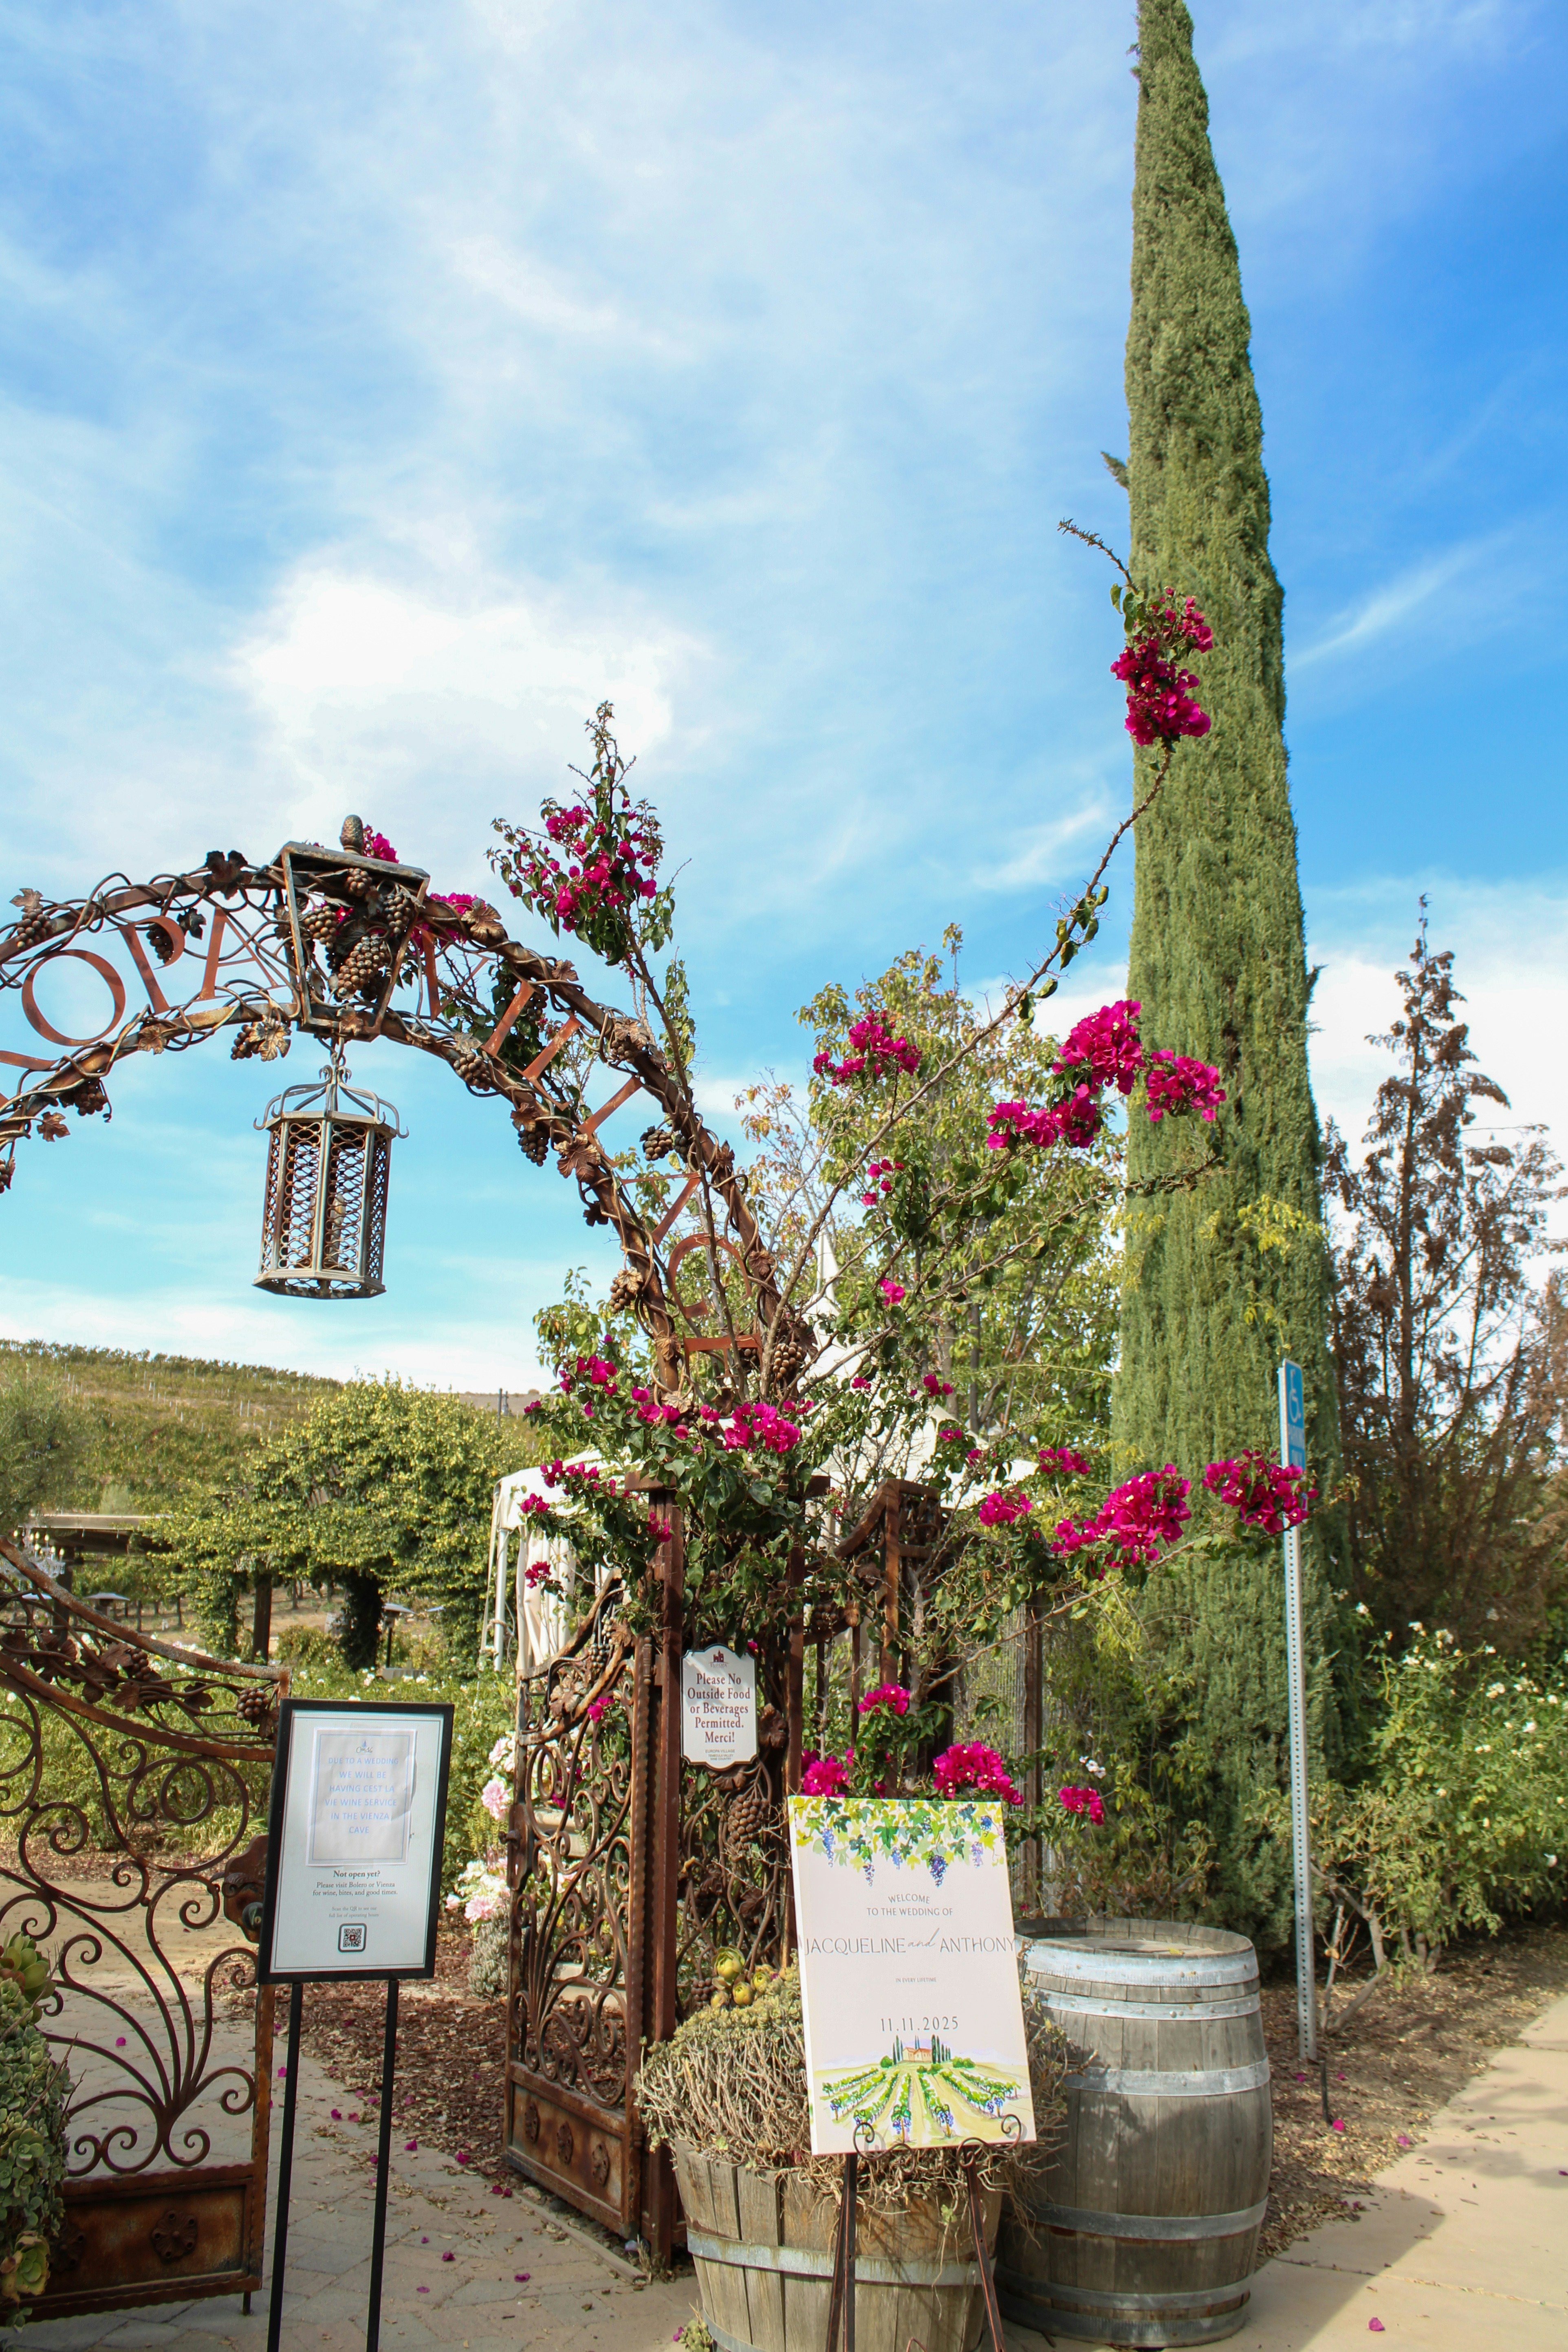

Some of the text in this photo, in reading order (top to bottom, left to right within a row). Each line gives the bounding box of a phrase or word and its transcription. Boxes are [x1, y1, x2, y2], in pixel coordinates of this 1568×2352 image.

[0, 905, 288, 1109] OPA
[696, 1673, 741, 1685] Please No
[688, 1687, 750, 1699] Outside Food
[703, 1702, 748, 1717] Beverages
[695, 1717, 744, 1728] Permitted.
[705, 1732, 735, 1743] Merci!
[367, 1870, 380, 1879] yet?
[888, 1893, 930, 1905] WELCOME
[867, 1907, 954, 1916] TO THE WEDDING OF
[804, 1928, 1015, 1956] JACQUELINE and ANTHONY
[880, 2016, 959, 2032] 11.11.2025
